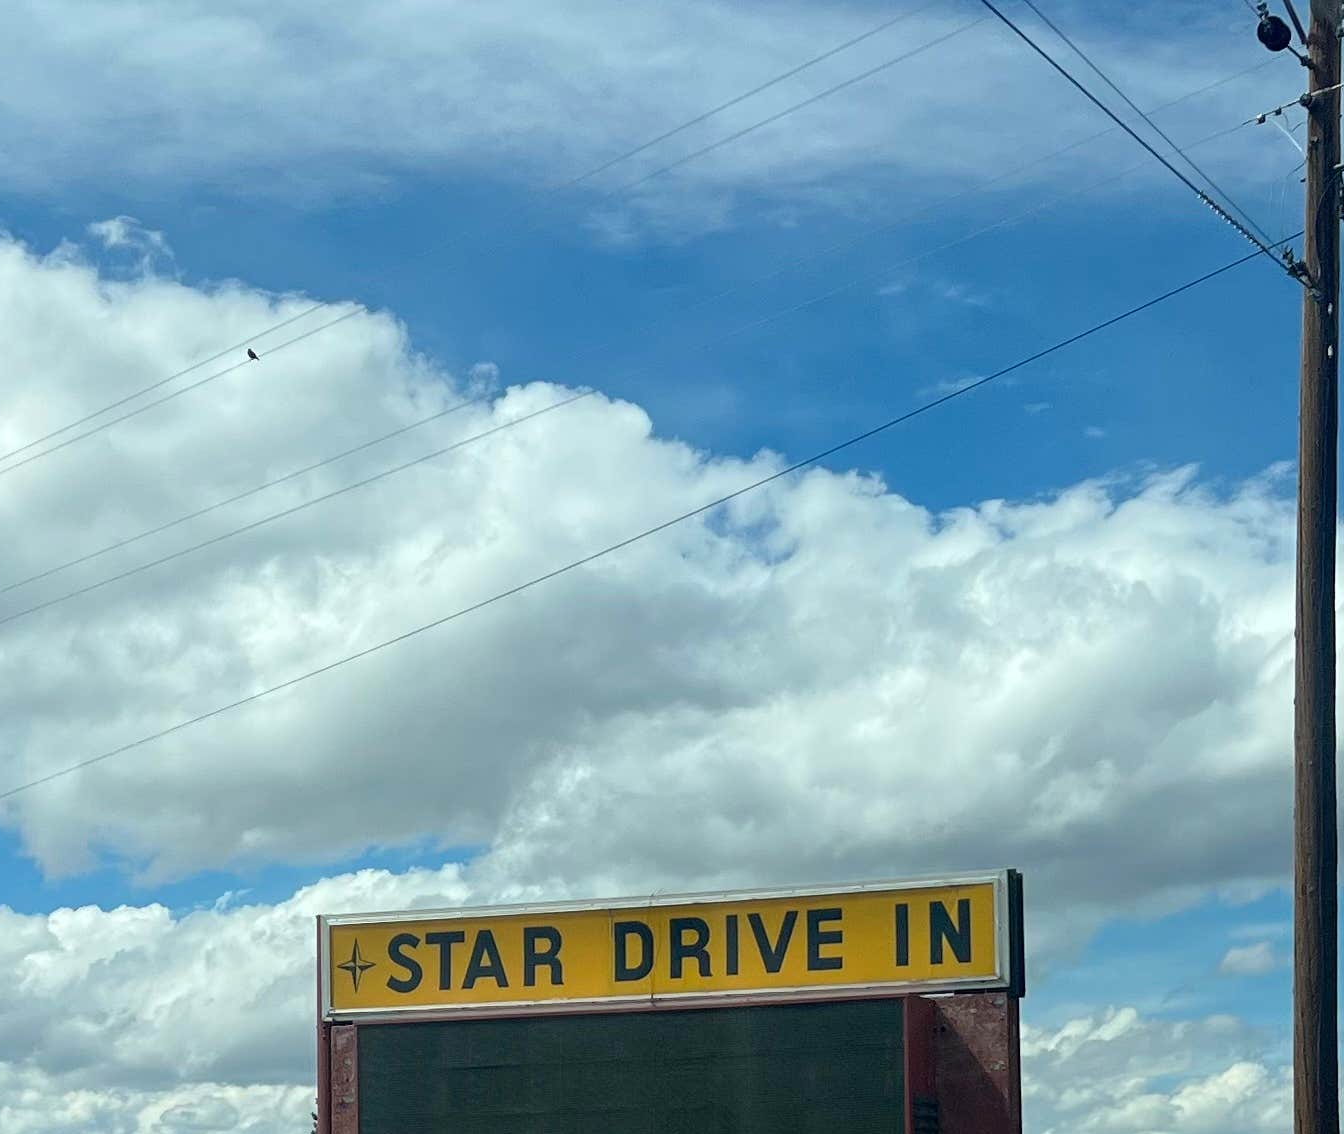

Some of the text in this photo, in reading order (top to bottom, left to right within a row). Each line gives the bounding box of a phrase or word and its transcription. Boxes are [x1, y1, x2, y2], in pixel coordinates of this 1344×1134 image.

[386, 899, 972, 993] STAR DRIVE IN
